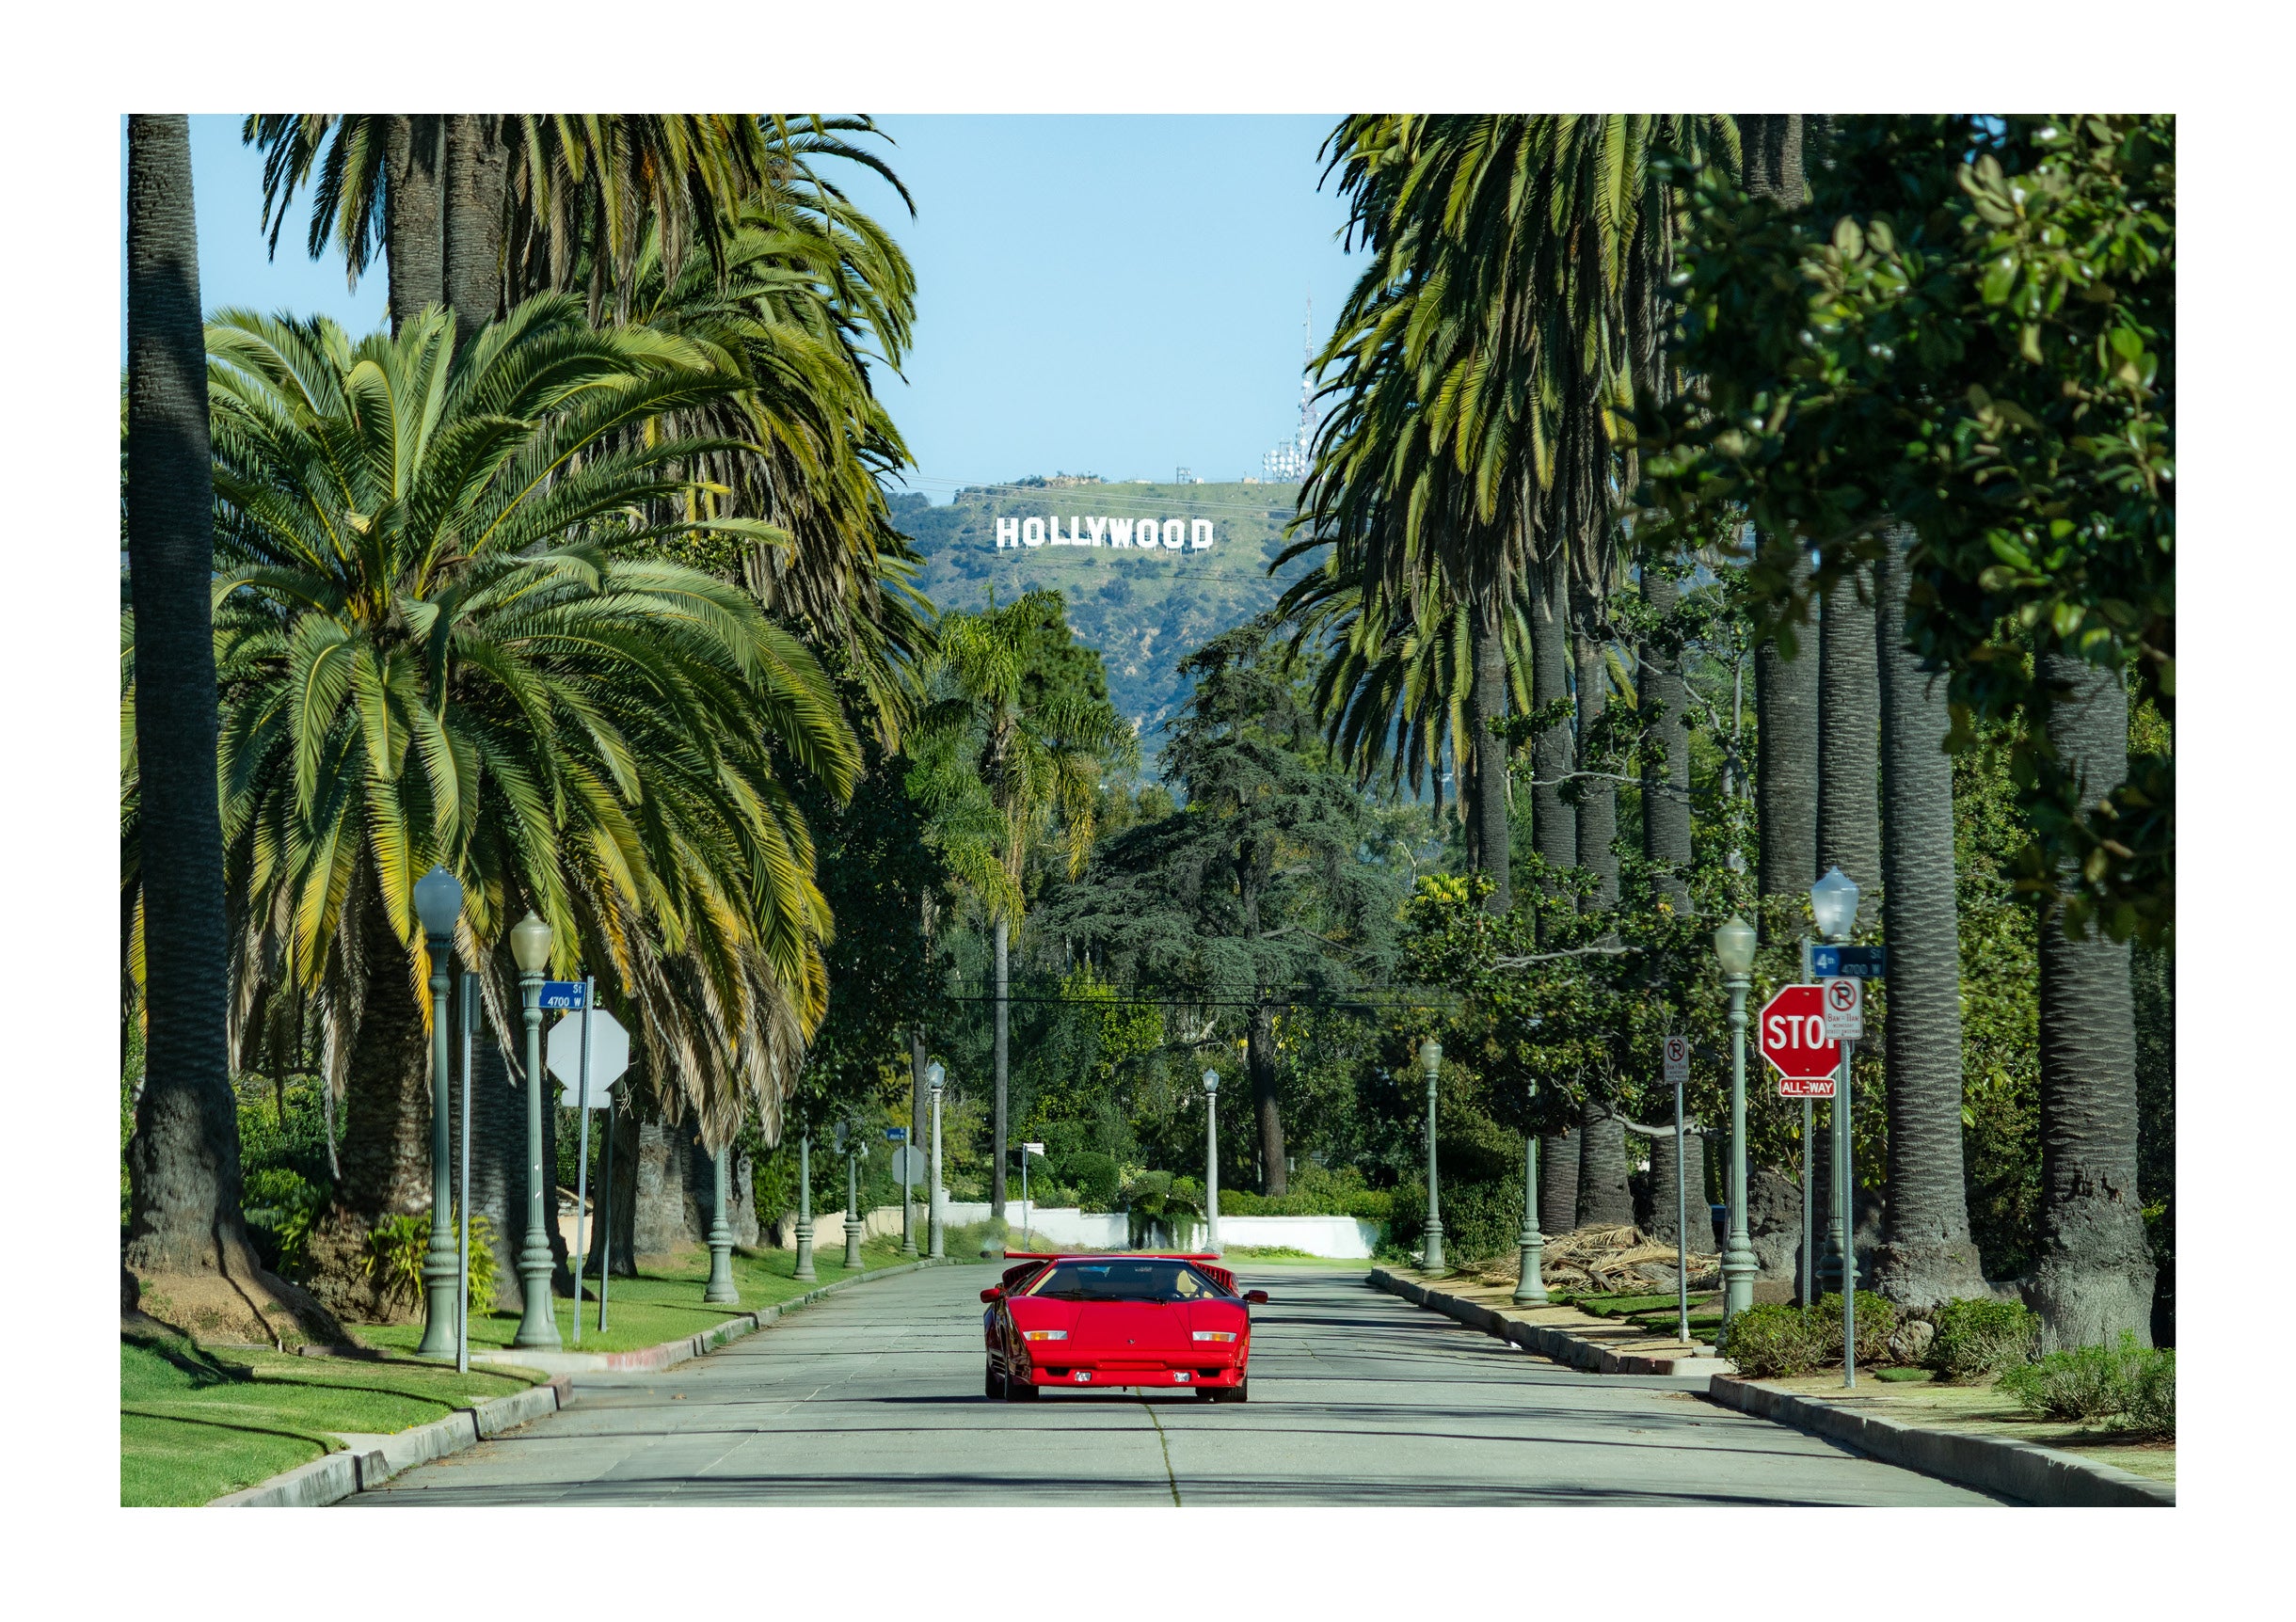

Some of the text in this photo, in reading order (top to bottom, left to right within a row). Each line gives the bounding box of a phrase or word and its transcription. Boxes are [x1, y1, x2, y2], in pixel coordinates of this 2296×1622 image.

[997, 517, 1213, 549] HOLLYWOOD
[1869, 947, 1882, 959] St
[1842, 963, 1881, 975] 4700 W
[572, 984, 582, 994] St
[548, 996, 582, 1007] 4700 W
[1782, 1082, 1833, 1093] ALL-WAY
